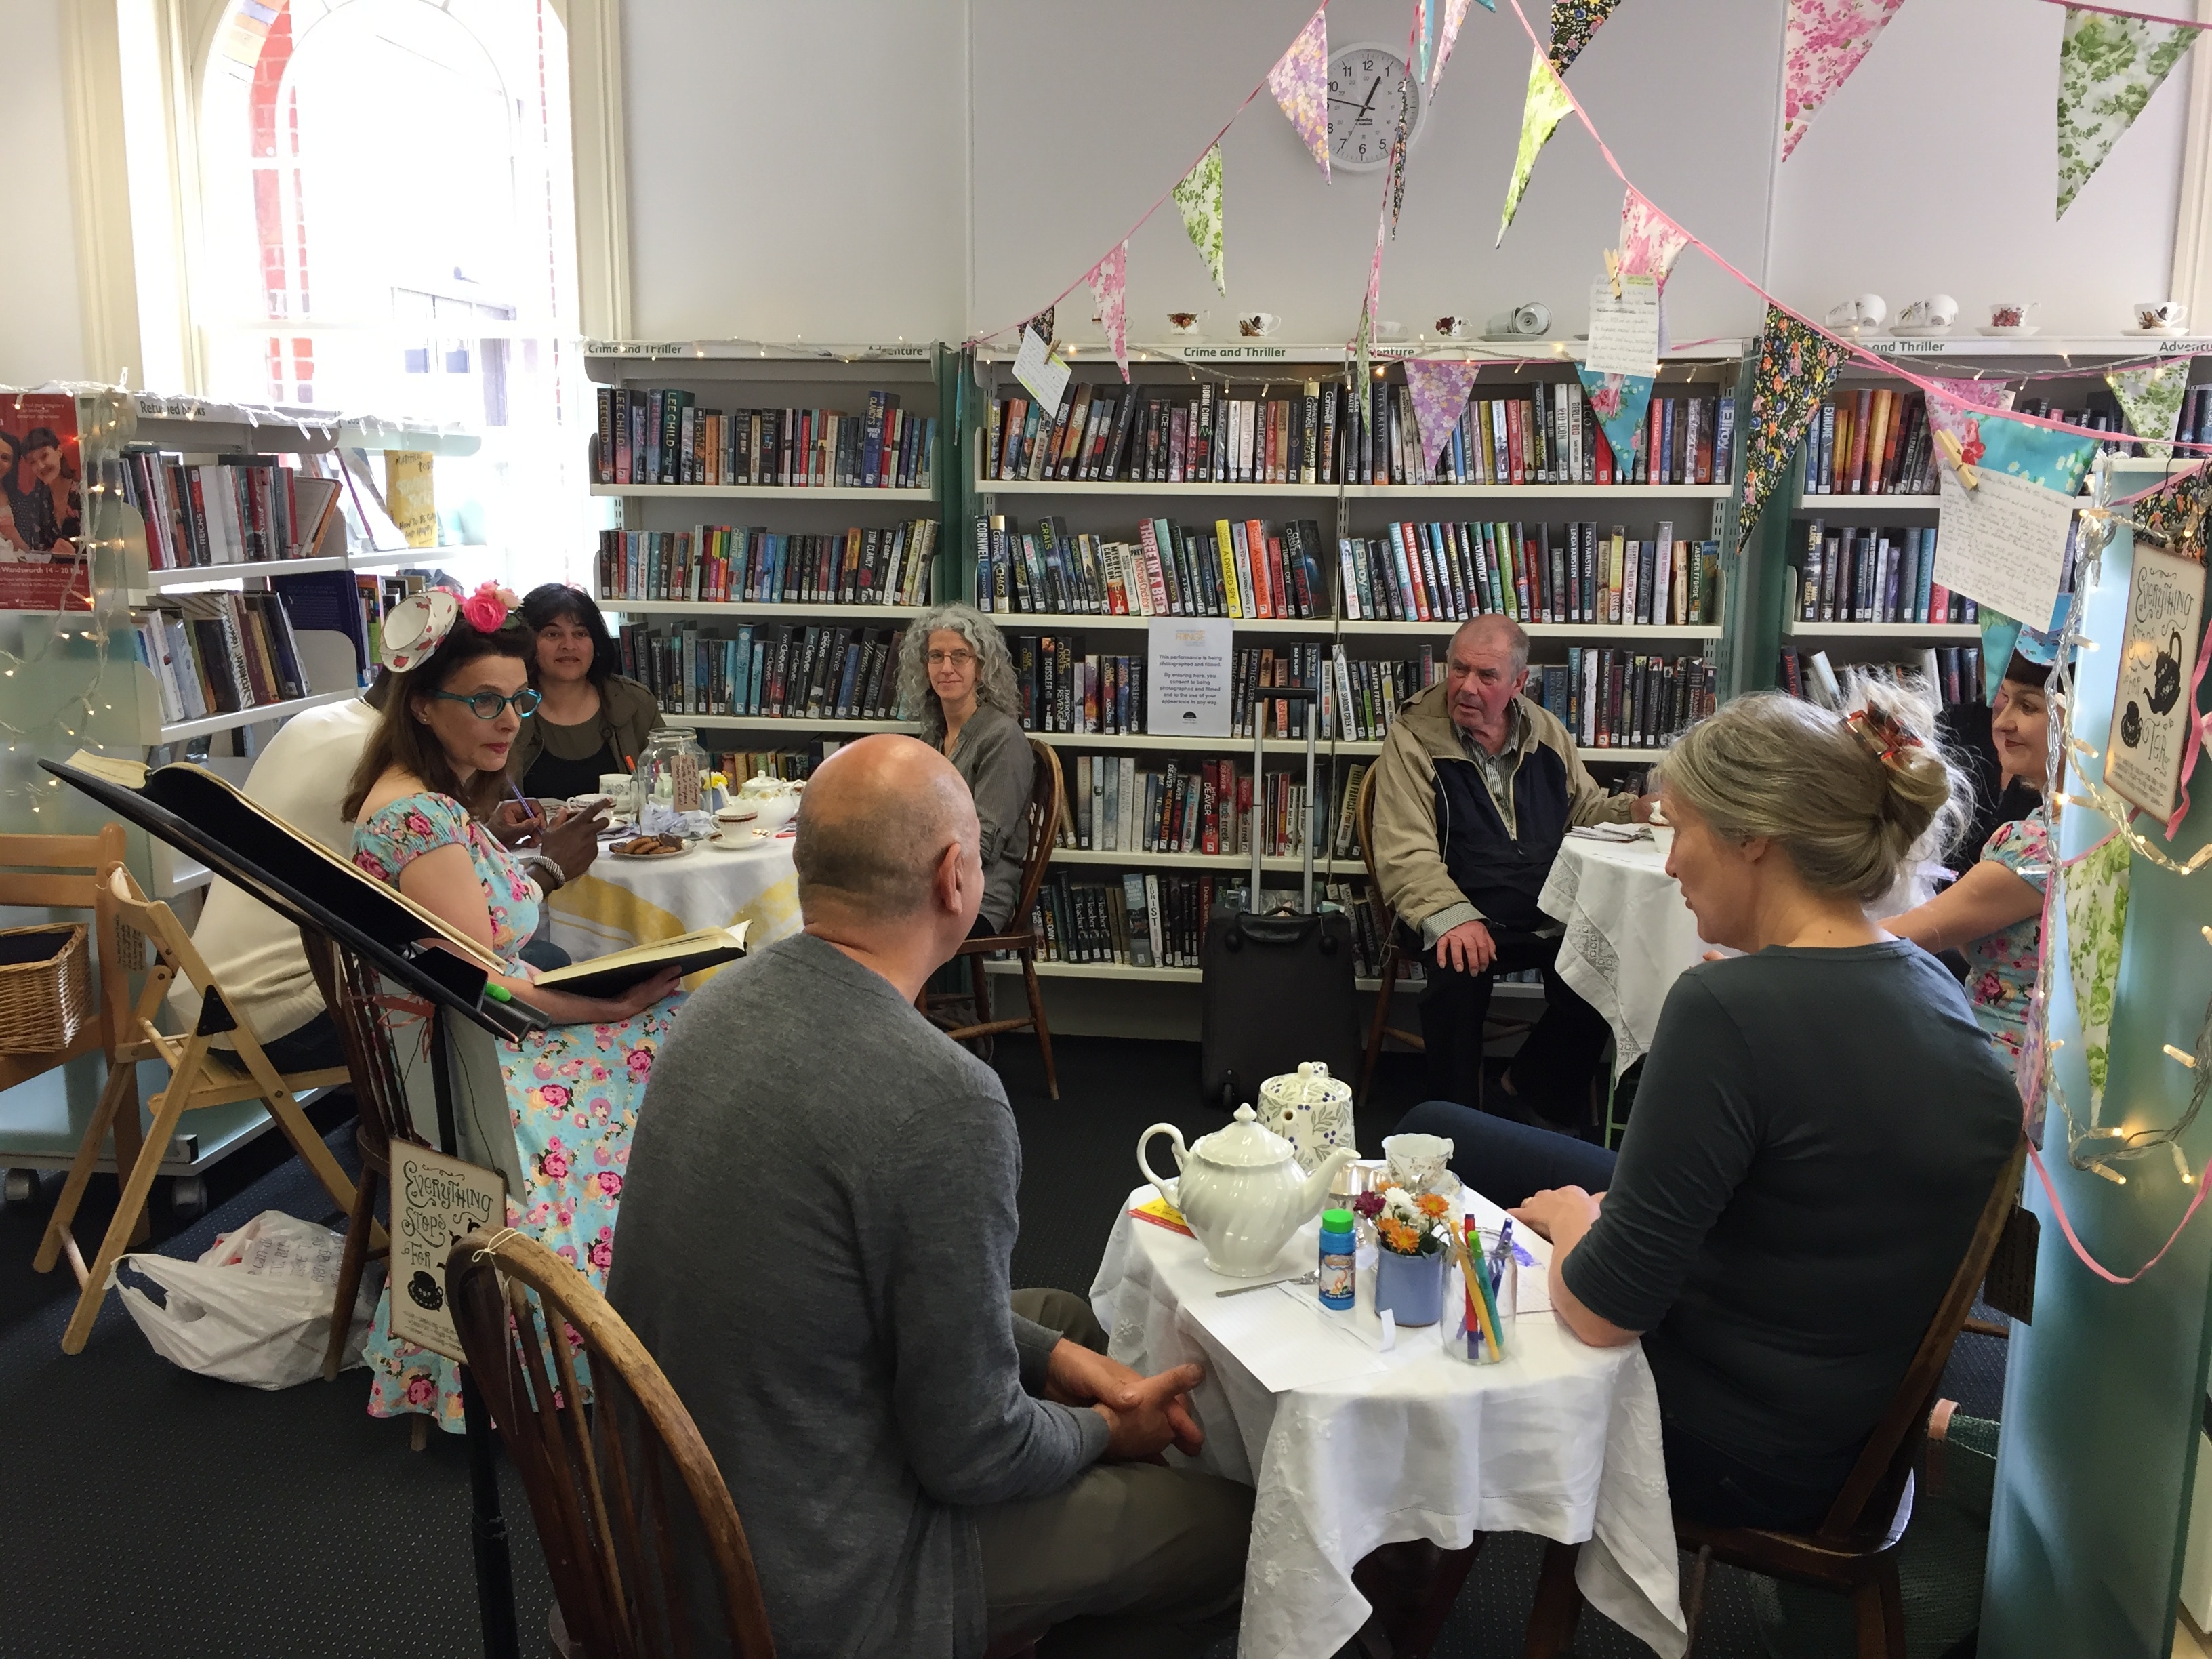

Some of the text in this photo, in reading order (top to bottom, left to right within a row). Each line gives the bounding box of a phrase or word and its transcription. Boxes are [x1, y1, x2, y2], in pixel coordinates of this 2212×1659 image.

[1343, 66, 1353, 77] 11
[1362, 60, 1374, 72] 12
[1385, 66, 1390, 77] 1
[1328, 81, 1339, 93] 10
[1339, 138, 1347, 149] 7
[1359, 143, 1366, 155] 6
[1379, 138, 1387, 149] 5
[588, 344, 619, 354] Crime
[1183, 347, 1286, 357] Crime and Thriller
[1872, 341, 1945, 352] and Thriller
[615, 390, 625, 446] LEE CHILD
[665, 392, 677, 447] LEE CHILD
[876, 405, 884, 419] TOM
[1200, 384, 1211, 426] ROBIN COOK
[1305, 396, 1314, 428] Cornwell
[1324, 390, 1334, 424] Cornwell
[1572, 402, 1580, 436] BERLIN RED
[600, 399, 609, 443] LEE CHILD
[1557, 408, 1568, 440] RED ICON
[1718, 409, 1734, 450] Ellroy
[1822, 407, 1835, 438] EXHUME
[196, 512, 205, 545] REICHS
[1040, 522, 1052, 550] CRAIS
[1286, 528, 1296, 558] CUSSLER
[737, 531, 745, 559] AGATHA
[865, 531, 877, 568] TOM CLANCY
[975, 523, 989, 565] CORNWELL
[1282, 548, 1290, 565] TURN
[1391, 527, 1409, 584] JANET EVANOVICH
[1406, 527, 1423, 584] JANET EVANOVICH
[1, 565, 44, 575] Wandsworth
[45, 567, 54, 575] 14
[60, 567, 69, 575] 20
[1103, 547, 1116, 581] CRICHTON
[1112, 546, 1123, 579] MICHAEL
[1140, 523, 1166, 609] THREE IN A BED
[1223, 557, 1232, 581] DIVIDED
[1254, 557, 1264, 581] COLDER
[1356, 548, 1368, 587] Ellroy
[1422, 549, 1435, 587] EVANOVICH
[1437, 548, 1449, 587] EVANOVICH
[1474, 544, 1488, 583] EVANOVICH
[996, 567, 1006, 596] CHAOS
[1134, 557, 1151, 609] Michael Crichton
[1227, 587, 1237, 600] SPY
[1257, 586, 1267, 602] WAR
[818, 630, 831, 659] Cleeves
[1175, 632, 1205, 641] FRINGE
[777, 643, 789, 674] Cleeves
[802, 644, 815, 674] Cleeves
[833, 645, 845, 672] Cleeves
[874, 650, 886, 676] Traitor
[1784, 655, 1795, 676] John
[1044, 661, 1053, 690] CUSSLER
[1132, 674, 1140, 701] CUSSLER
[1338, 672, 1347, 691] FIELDING
[1370, 665, 1382, 715] JASPER FFORDE
[1057, 689, 1065, 721] REVENGE
[1340, 693, 1349, 712] SHADOW
[1343, 712, 1351, 727] CREEK
[1166, 764, 1174, 789] DEAVER
[1164, 798, 1172, 825] OCTOBER
[1204, 782, 1212, 816] DEAVER
[1161, 825, 1170, 840] LIST
[1222, 820, 1230, 842] creek
[1045, 910, 1055, 940] JACKDAW
[1075, 901, 1085, 930] Teacher
[1087, 900, 1097, 928] Teacher
[1097, 899, 1108, 928] Teacher
[401, 1206, 447, 1249] STOPS
[401, 1240, 432, 1270] FOR
